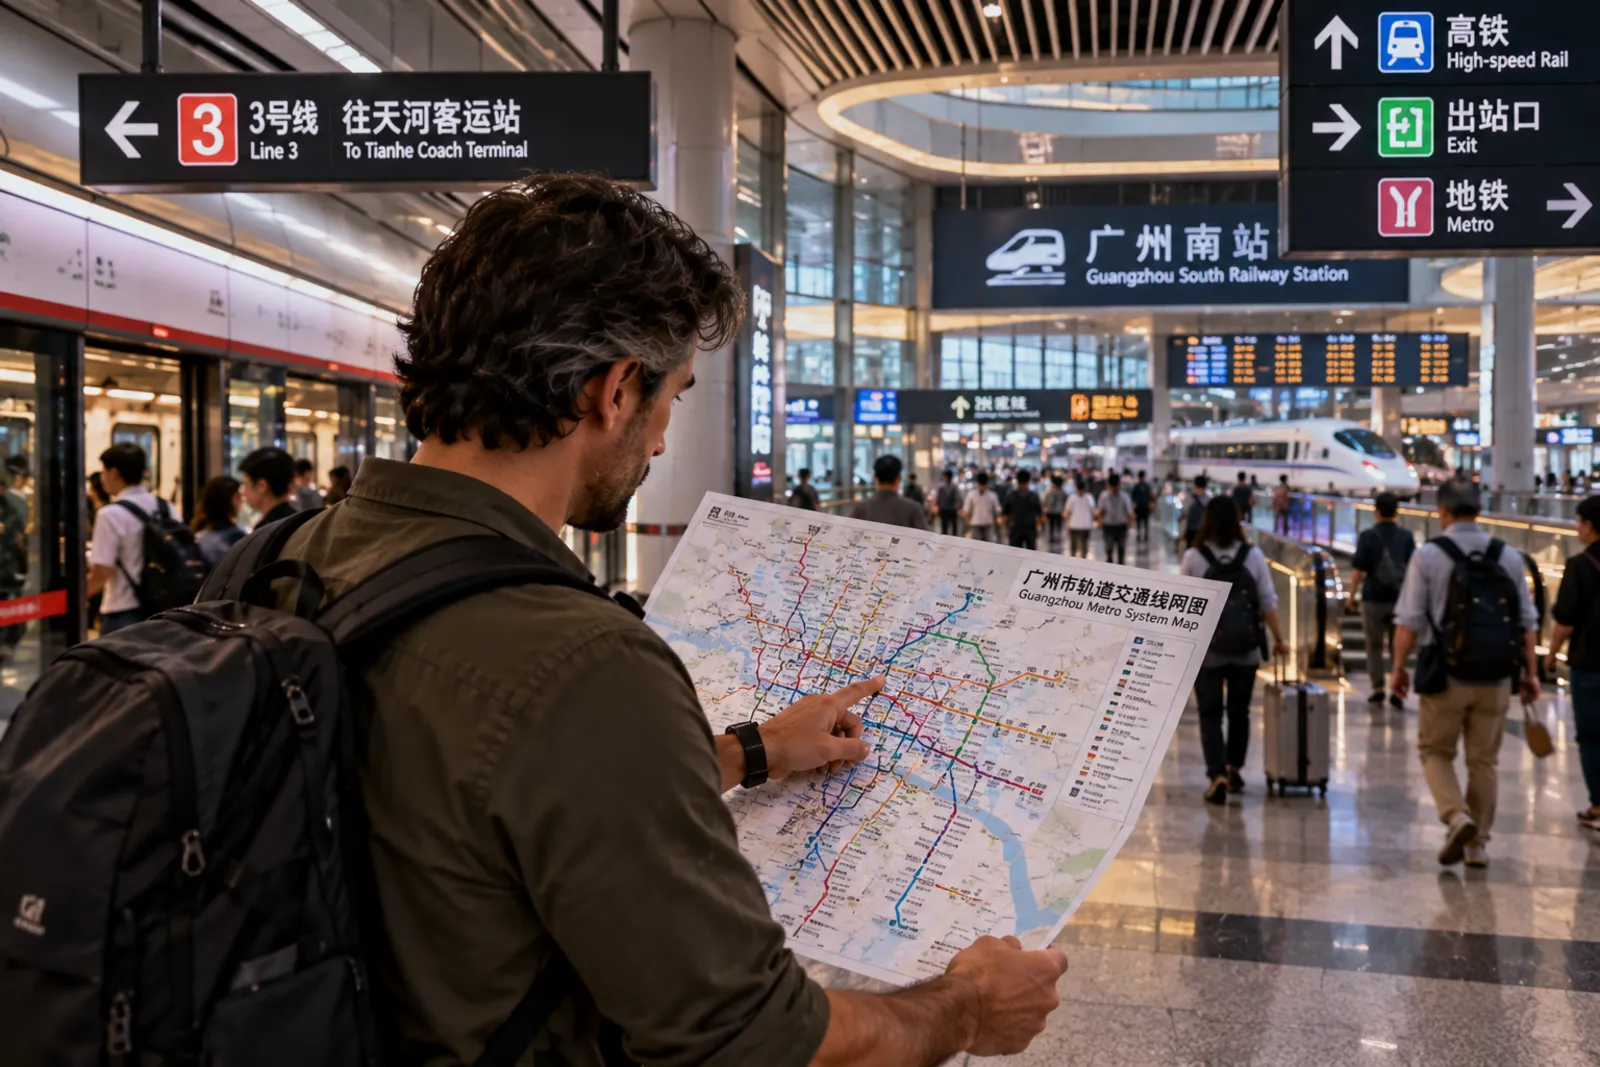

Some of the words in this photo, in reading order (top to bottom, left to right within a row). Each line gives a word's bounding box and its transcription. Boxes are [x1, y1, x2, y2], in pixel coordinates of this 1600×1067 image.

[1446, 13, 1510, 48] 高铁
[1447, 51, 1536, 73] High-speed
[1540, 51, 1569, 68] Rail
[192, 102, 224, 156] 3
[249, 99, 319, 136] 3号线
[342, 98, 521, 136] 往天河客运站
[1447, 98, 1540, 133] 出站口
[250, 141, 285, 160] Line
[288, 141, 299, 160] 3
[342, 141, 362, 159] To
[364, 140, 415, 160] Tianhe
[417, 140, 463, 160] Coach
[465, 140, 528, 160] Terminal
[1447, 136, 1478, 154] Exit
[1445, 178, 1509, 212] 地铁
[1447, 216, 1495, 233] Metro
[1085, 222, 1270, 264] 广州南站
[1086, 265, 1175, 288] Guangzhou
[1178, 265, 1225, 284] South
[1229, 264, 1290, 286] Railway
[1293, 264, 1349, 283] Station
[1018, 588, 1083, 610] Guangzhou
[1086, 601, 1122, 617] Metro
[1125, 607, 1169, 625] System
[1171, 616, 1199, 632] Map
[1023, 569, 1209, 616] 广州市轨道交通线网图
